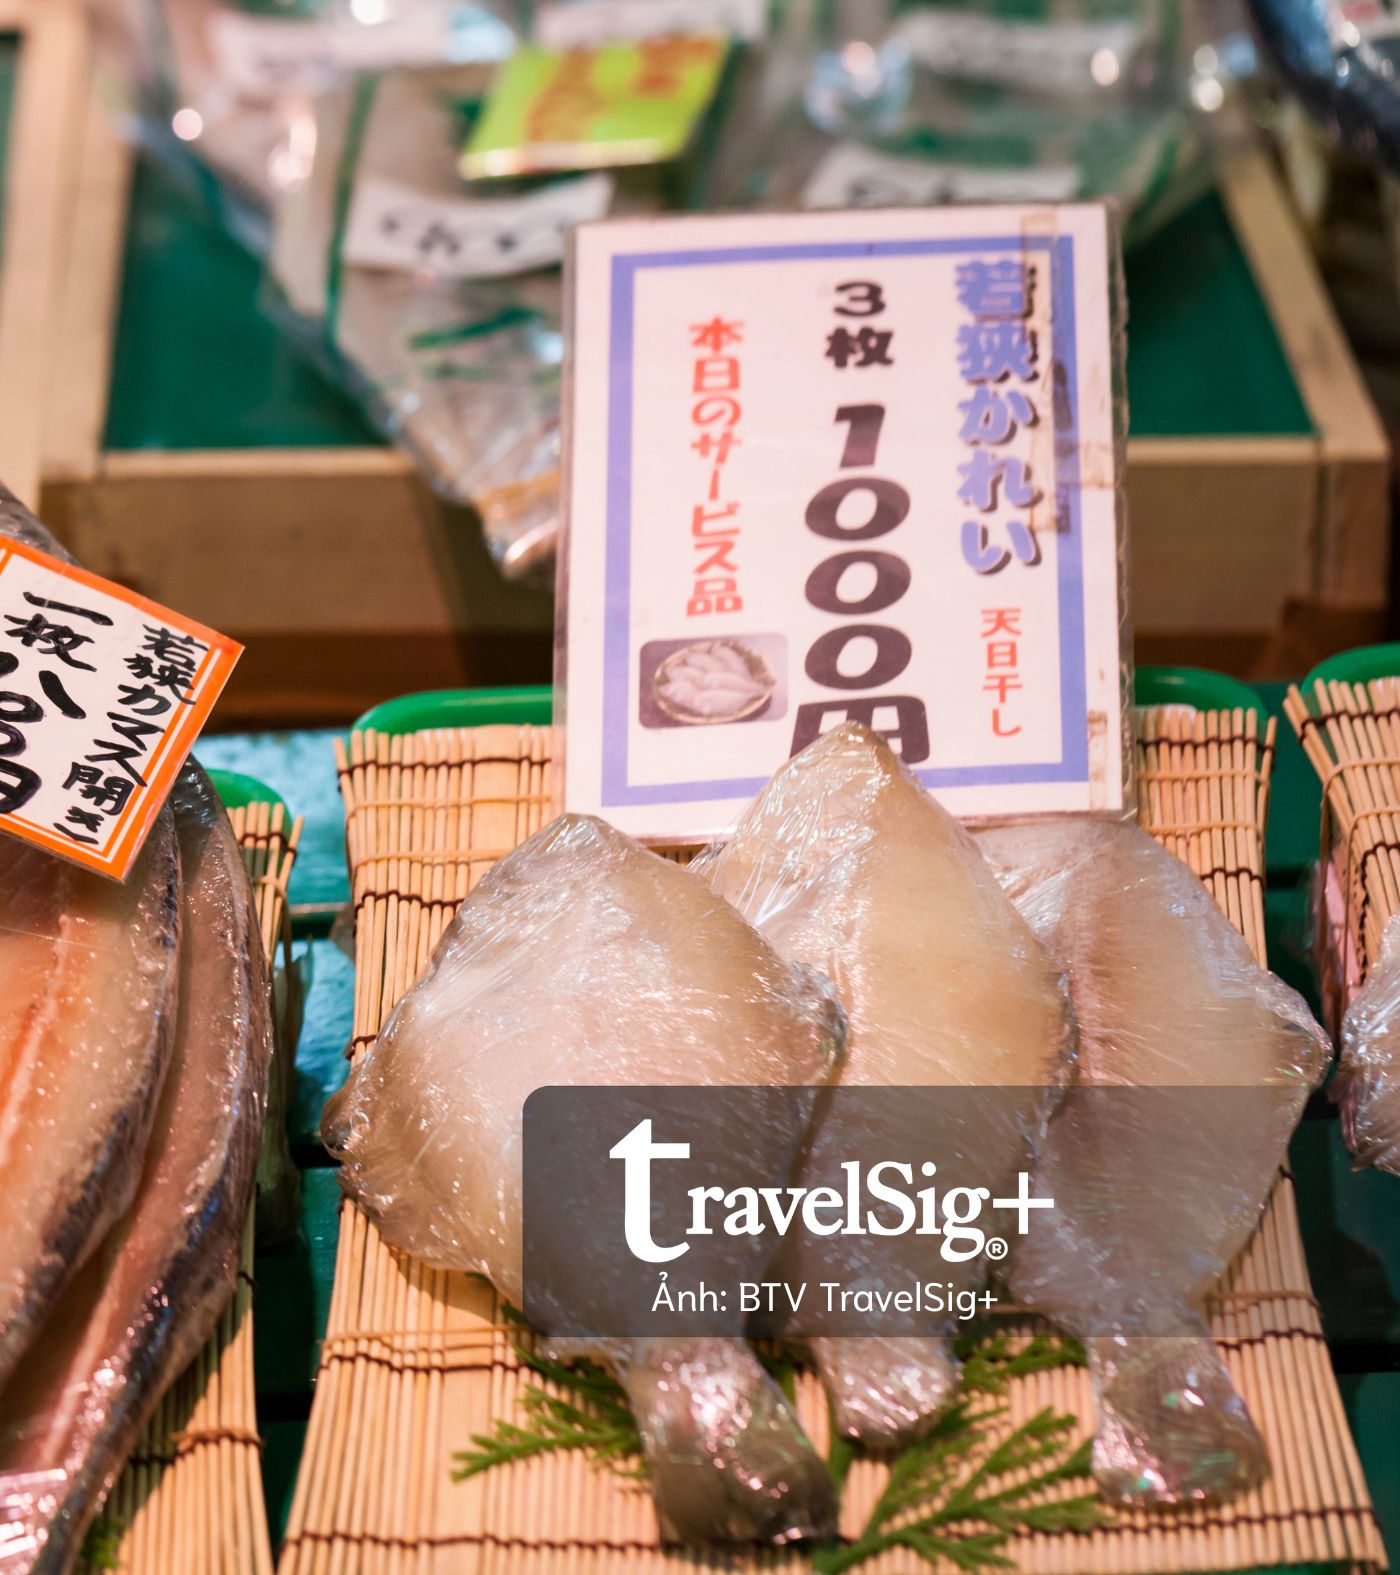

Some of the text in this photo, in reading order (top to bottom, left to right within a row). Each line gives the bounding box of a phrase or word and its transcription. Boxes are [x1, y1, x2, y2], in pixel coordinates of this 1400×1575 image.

[686, 316, 744, 617] 本日のサービス品
[789, 281, 930, 764] 3枚 1000円
[954, 258, 1044, 738] 若狭かれい 天日干し
